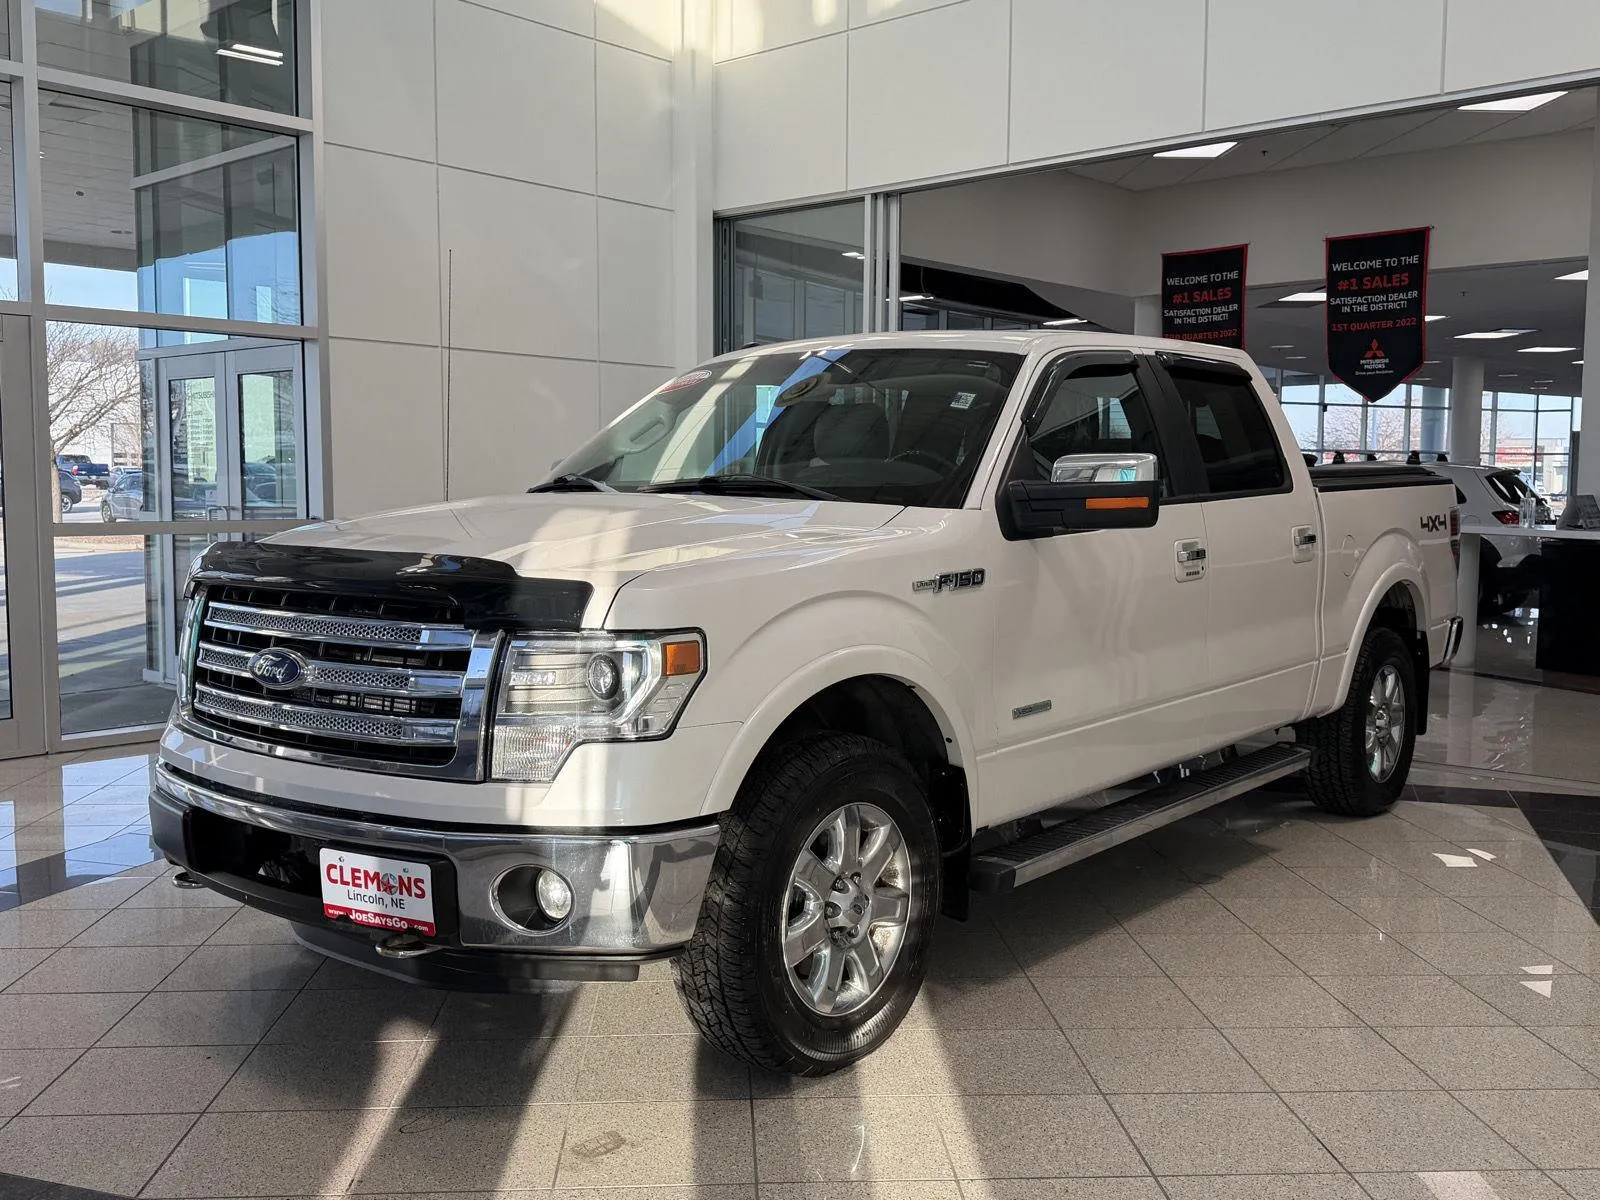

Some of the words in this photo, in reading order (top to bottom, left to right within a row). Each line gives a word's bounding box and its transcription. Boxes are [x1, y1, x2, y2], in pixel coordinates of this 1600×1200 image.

[1332, 259, 1382, 272] WELCOME
[1384, 257, 1398, 267] TO
[1400, 254, 1420, 265] THE
[1166, 275, 1208, 286] WELCOME
[1210, 273, 1222, 283] TO
[1222, 270, 1239, 280] THE
[1337, 278, 1359, 291] #1
[1362, 272, 1409, 290] SALES
[1172, 292, 1190, 304] #1
[1193, 287, 1231, 302] SALES
[1330, 294, 1386, 306] SATISFACTION
[1388, 290, 1418, 301] DEALER
[1164, 308, 1211, 317] SATISFACTION
[1212, 303, 1239, 314] DEALER
[1341, 305, 1351, 313] IN
[1352, 304, 1368, 313] THE
[1370, 300, 1407, 311] DISTRICT!
[1198, 313, 1229, 323] DISTRICT!
[1331, 323, 1348, 332] 1ST
[1350, 320, 1393, 331] QUARTER
[1395, 317, 1417, 327] 2022
[1182, 331, 1219, 341] QUARTER
[1220, 328, 1238, 337] 2022
[255, 654, 288, 682] Ford
[326, 863, 426, 899] CLEMONS
[347, 889, 388, 908] Lincoln,
[391, 898, 405, 909] NE
